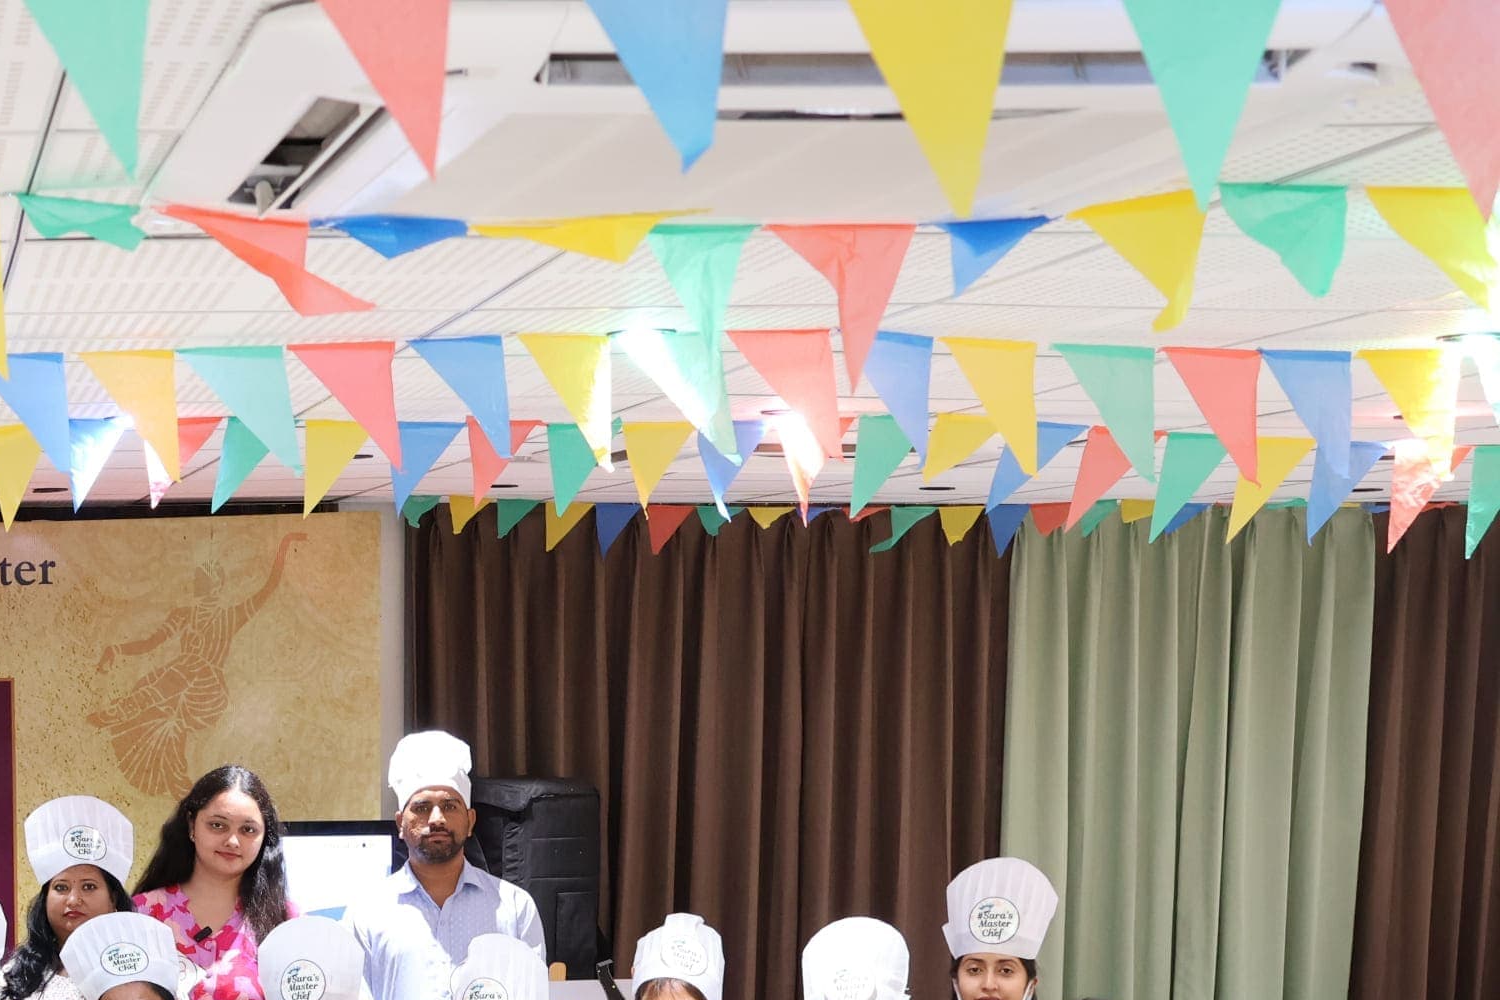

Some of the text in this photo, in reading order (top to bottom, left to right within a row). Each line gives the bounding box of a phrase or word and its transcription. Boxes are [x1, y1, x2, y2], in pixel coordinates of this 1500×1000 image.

[977, 910, 1013, 920] #Sara's
[978, 920, 1012, 928] Master
[982, 928, 1003, 940] Chef
[112, 957, 141, 967] Master
[118, 963, 137, 973] Chef
[287, 973, 320, 984] #Sara's
[288, 983, 318, 992] Master
[469, 990, 502, 1000] #Sara's
